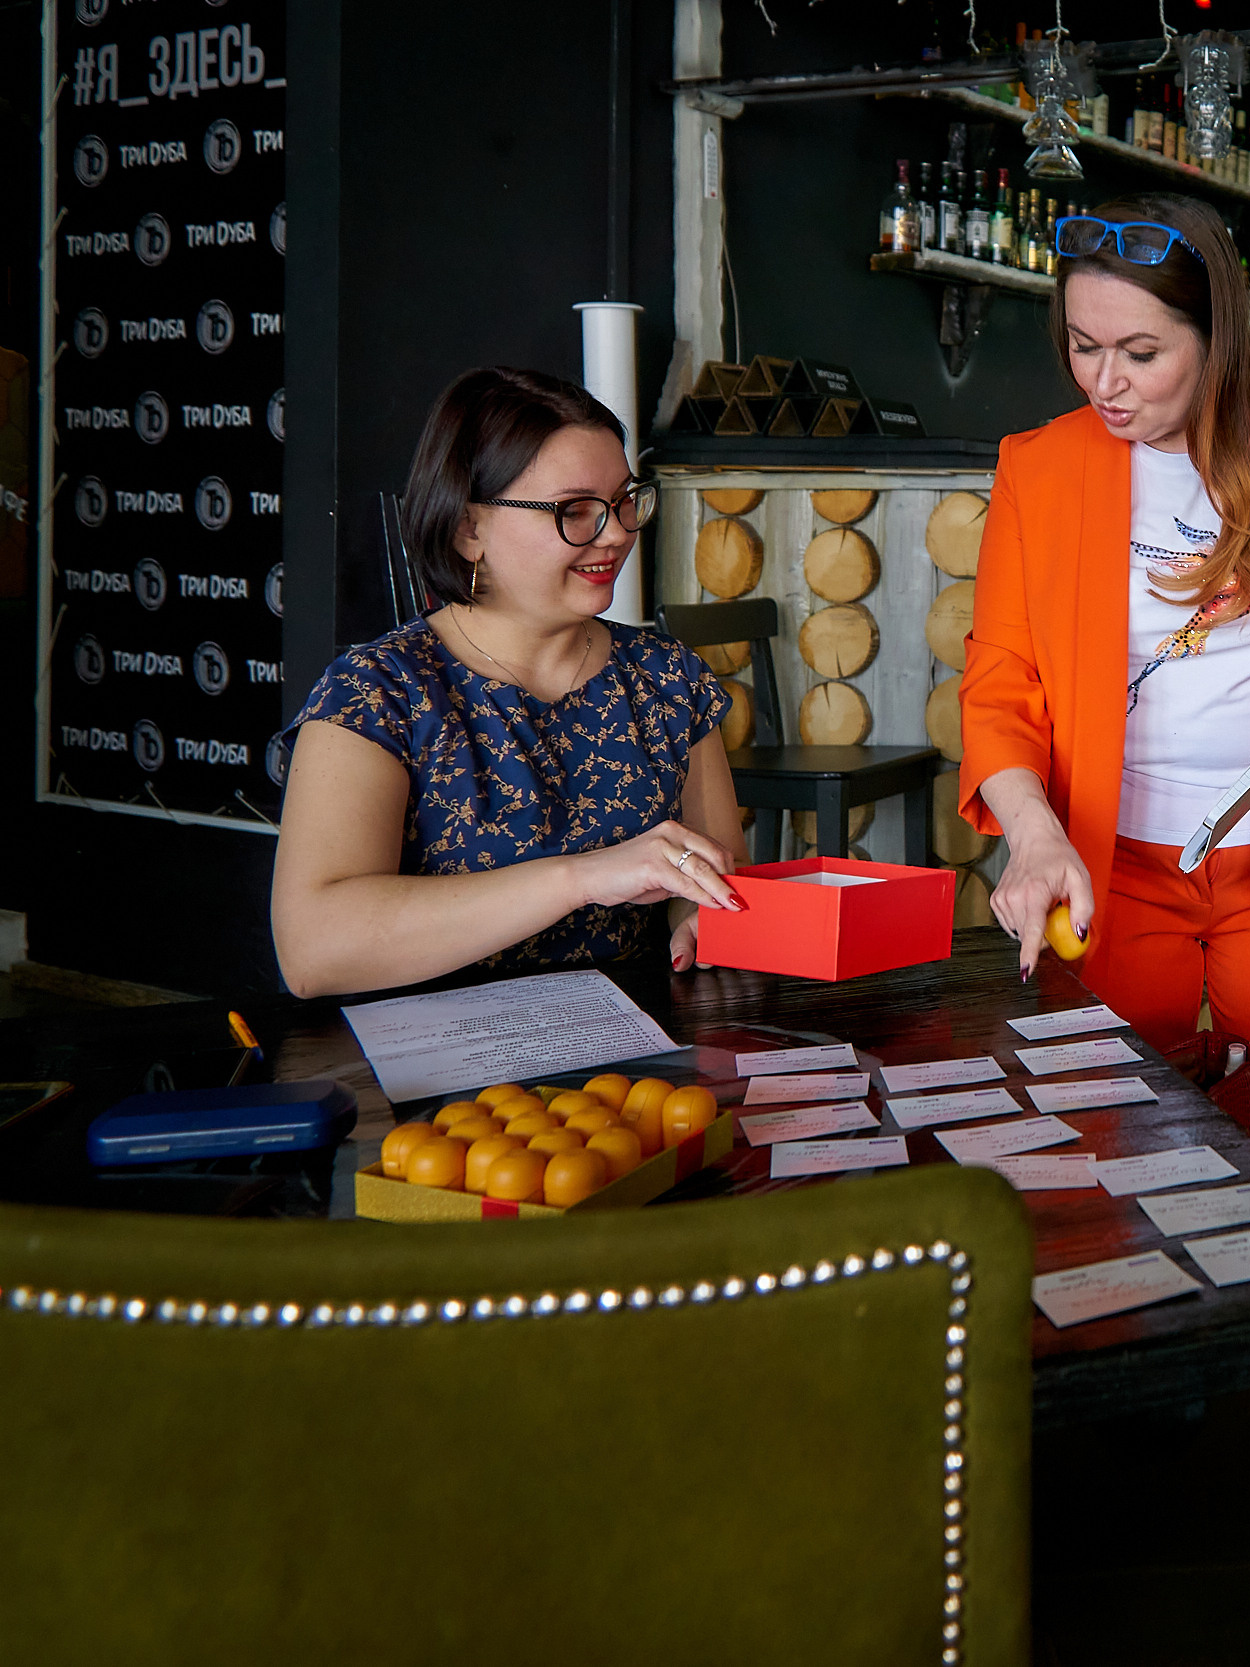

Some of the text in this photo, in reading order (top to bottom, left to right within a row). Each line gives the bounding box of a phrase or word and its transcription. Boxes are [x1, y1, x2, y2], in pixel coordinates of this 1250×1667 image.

[254, 130, 283, 153] ТРИ
[120, 146, 147, 168] ТРИ
[66, 235, 91, 256] ТРИ
[186, 225, 214, 247] ТРИ
[121, 320, 147, 342] ТРИ
[252, 313, 280, 335] ТРИ
[66, 408, 90, 428] ТРИ
[183, 406, 210, 427] ТРИ
[116, 491, 144, 511] ТРИ
[251, 492, 279, 514] ТРИ
[66, 570, 89, 589] ТРИ
[179, 575, 207, 596] ТРИ
[113, 651, 142, 671] ТРИ
[248, 660, 277, 682] ТРИ
[62, 726, 87, 746] ТРИ
[176, 738, 206, 760] ТРИ
